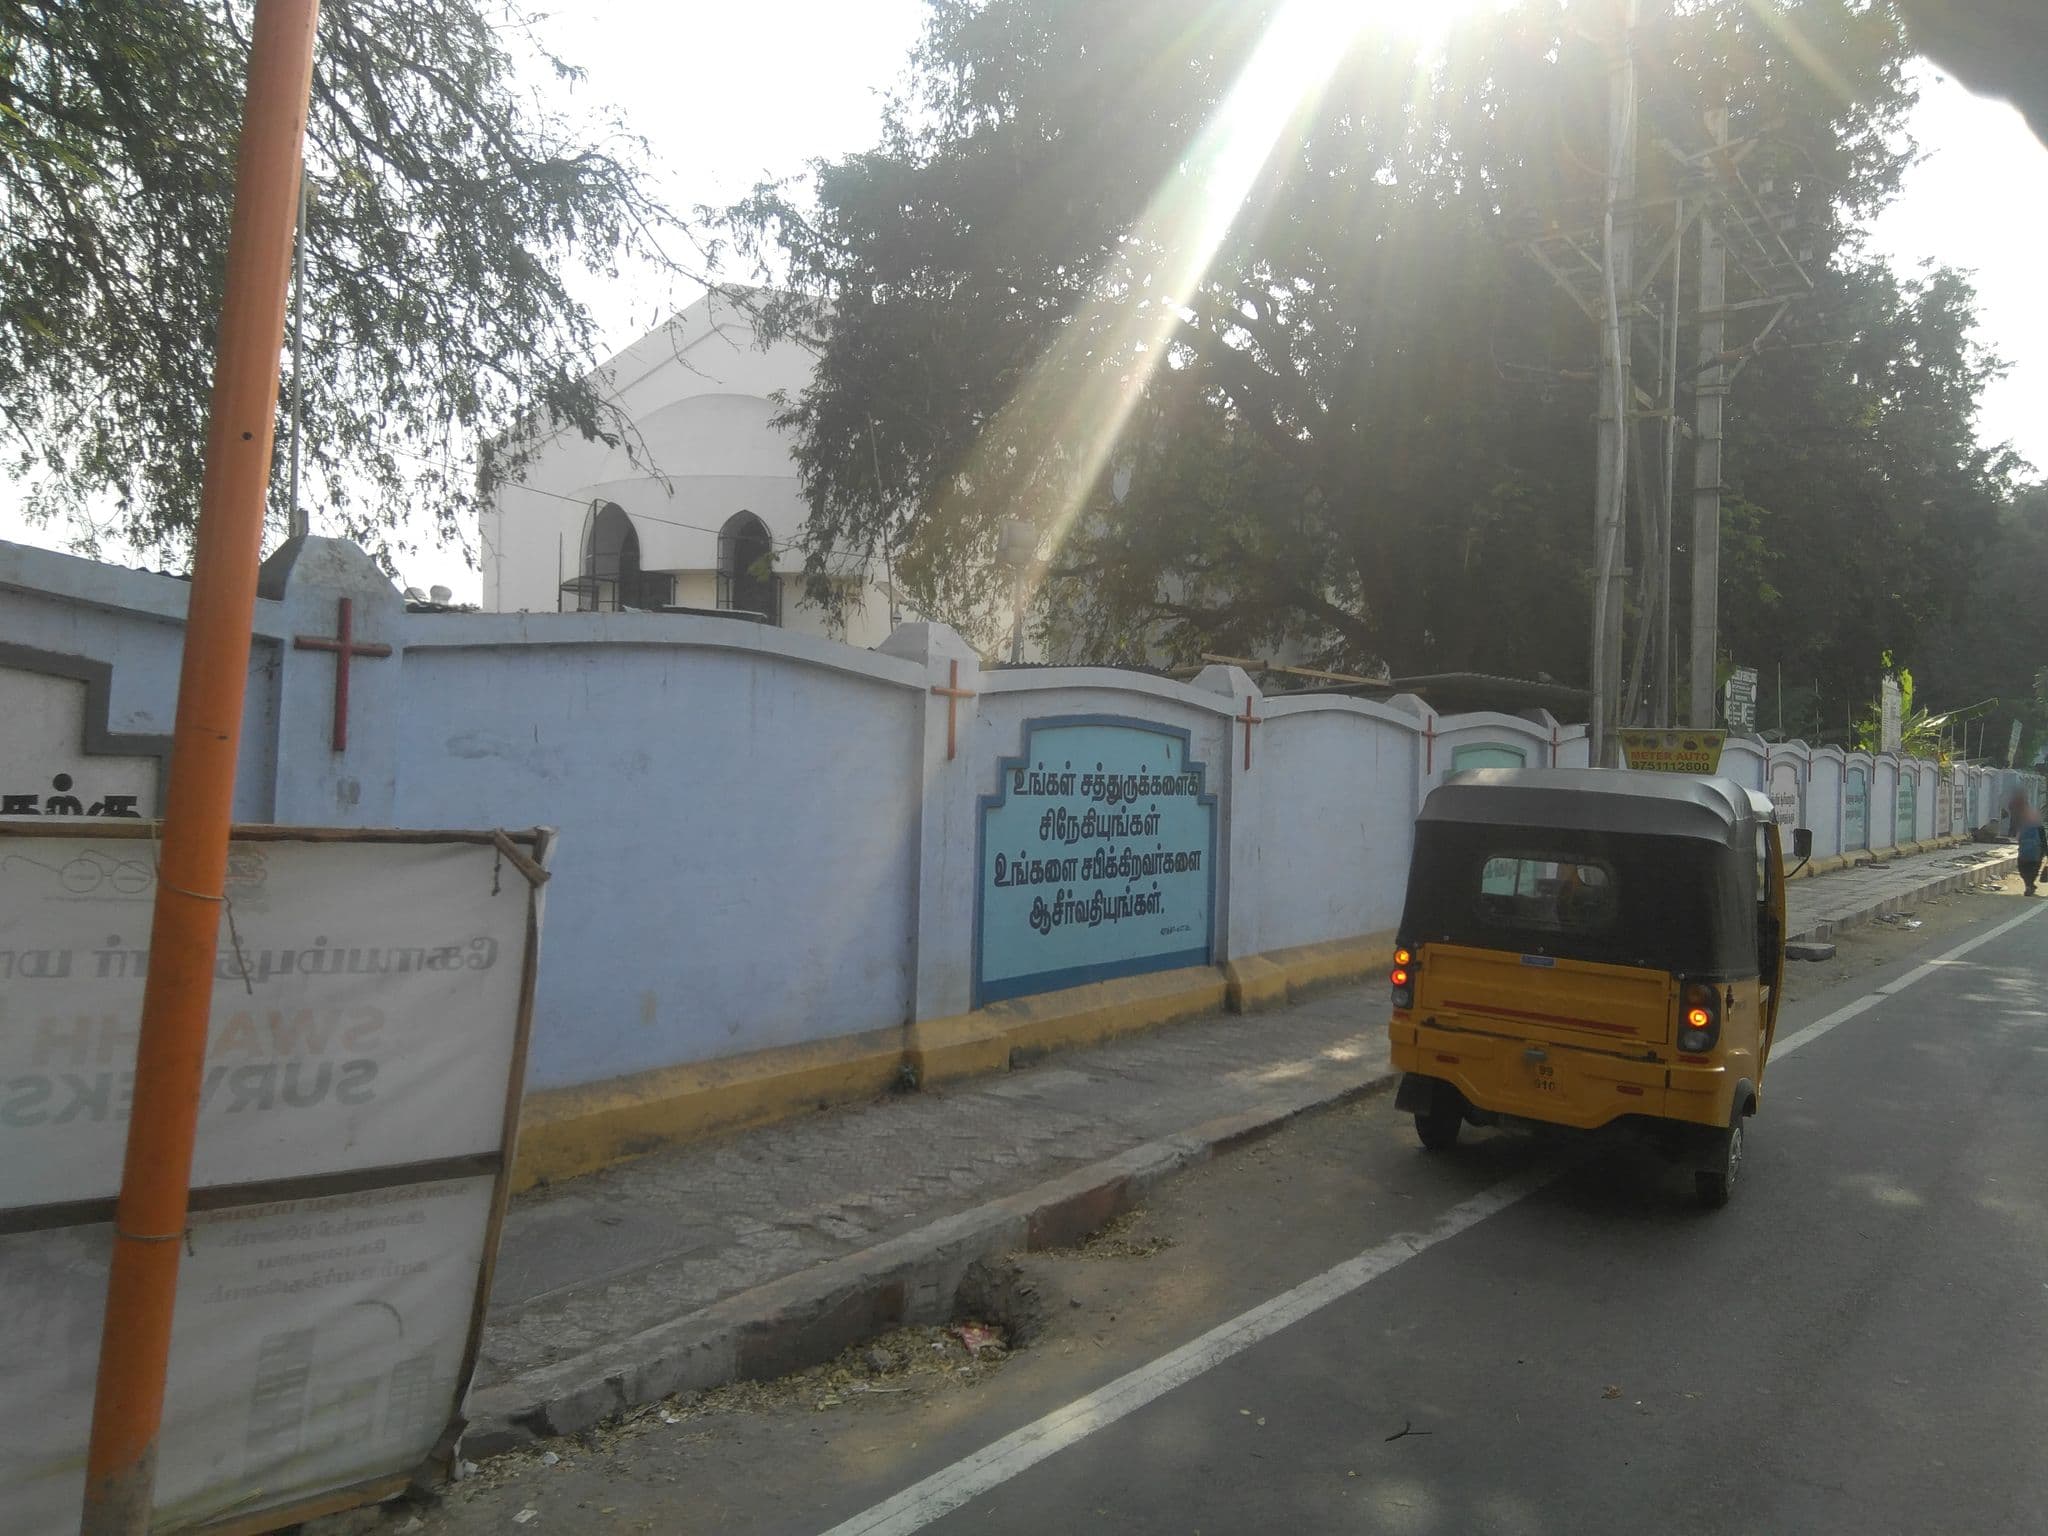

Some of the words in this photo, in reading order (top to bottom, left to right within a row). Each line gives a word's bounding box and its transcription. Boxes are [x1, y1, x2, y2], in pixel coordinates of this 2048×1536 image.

[1631, 751, 1672, 761] METER
[1676, 752, 1710, 761] AUTO
[1013, 761, 1076, 796] உங்கள்
[1039, 803, 1161, 845] சிநேகியுங்கள்
[994, 850, 1078, 888] உங்களை
[1081, 843, 1202, 883] சபிக்கிறவர்களை
